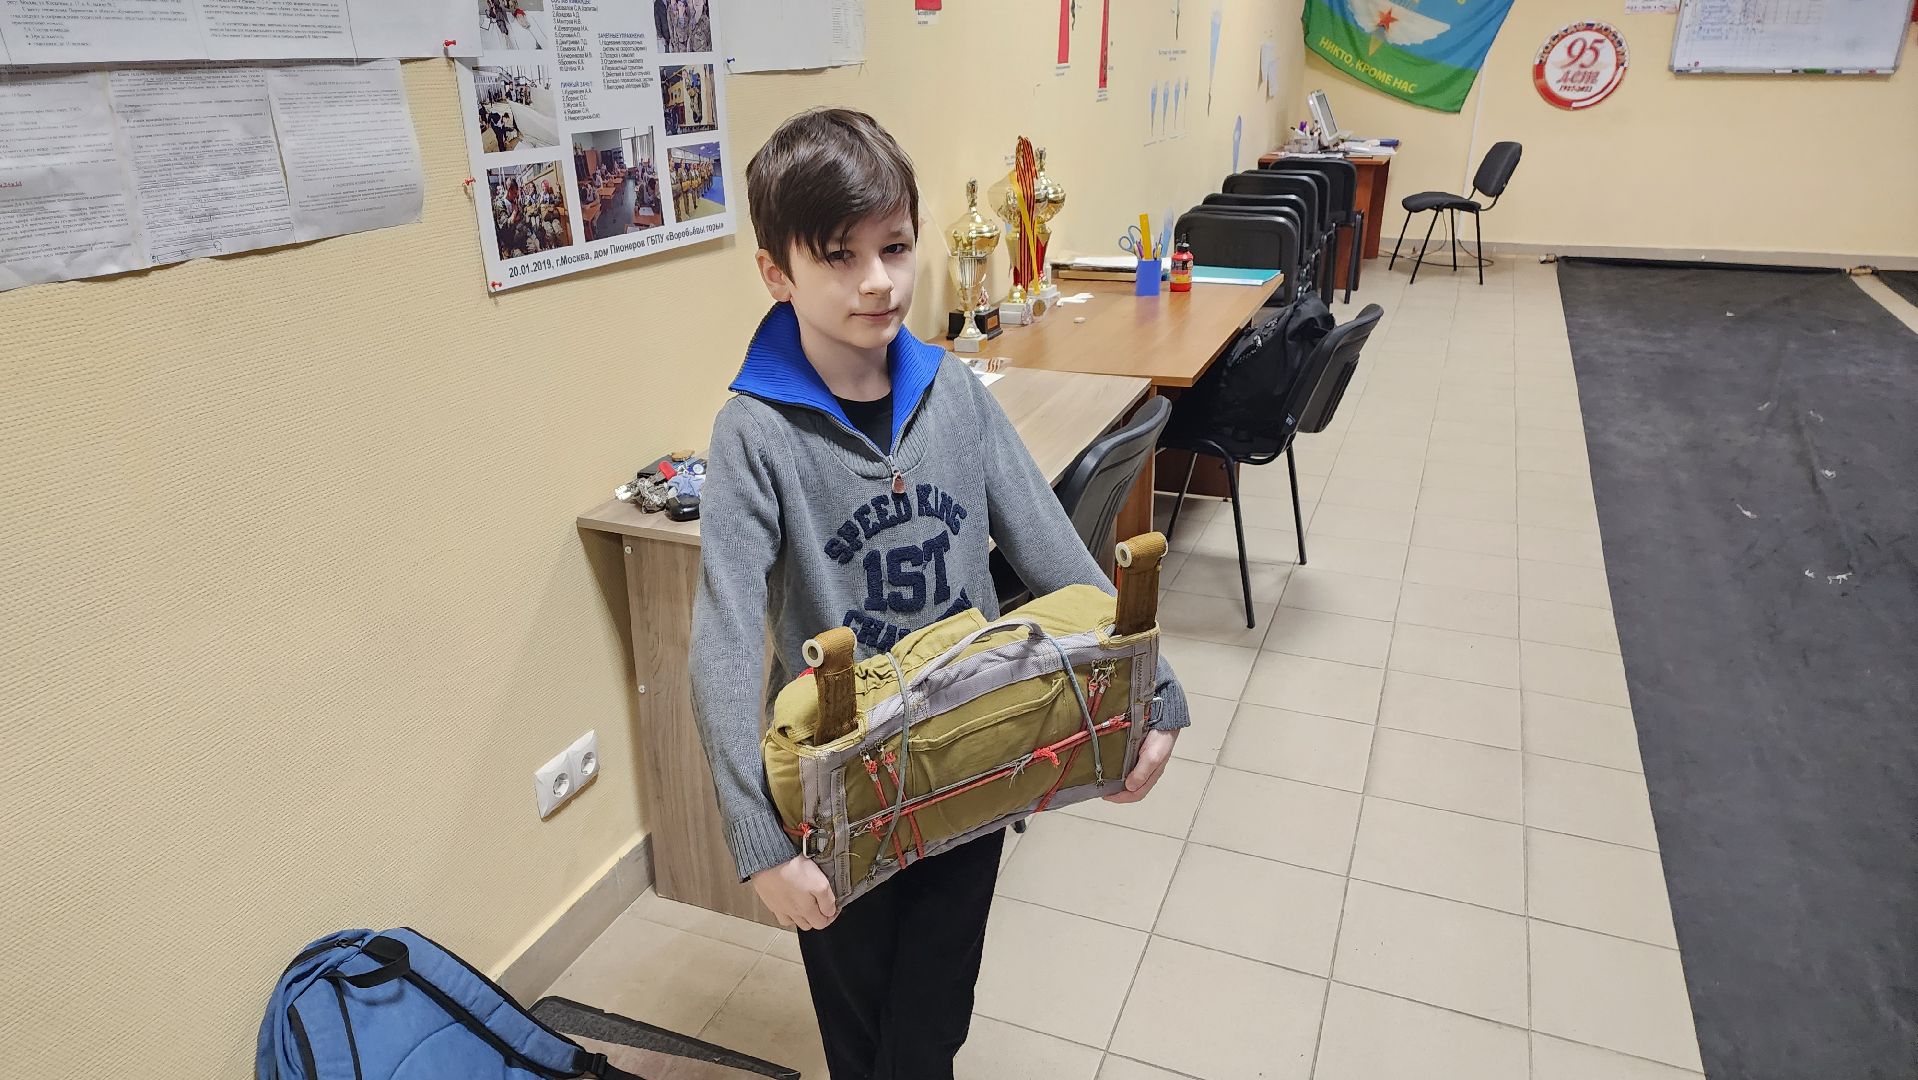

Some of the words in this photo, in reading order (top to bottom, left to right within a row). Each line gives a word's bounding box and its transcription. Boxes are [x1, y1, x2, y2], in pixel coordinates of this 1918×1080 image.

[1319, 36, 1355, 67] НИКТО,
[1355, 59, 1392, 85] КРОМЕ
[1393, 77, 1419, 93] НАС
[1560, 37, 1606, 68] 95
[508, 258, 554, 278] 20.01.2019,
[556, 252, 592, 267] г.Москва,
[593, 249, 608, 259] дом
[610, 240, 645, 254] Пионеров
[706, 222, 724, 233] горы»
[824, 492, 913, 565] SPEED
[915, 483, 968, 536] KING
[863, 530, 951, 613] 1ST
